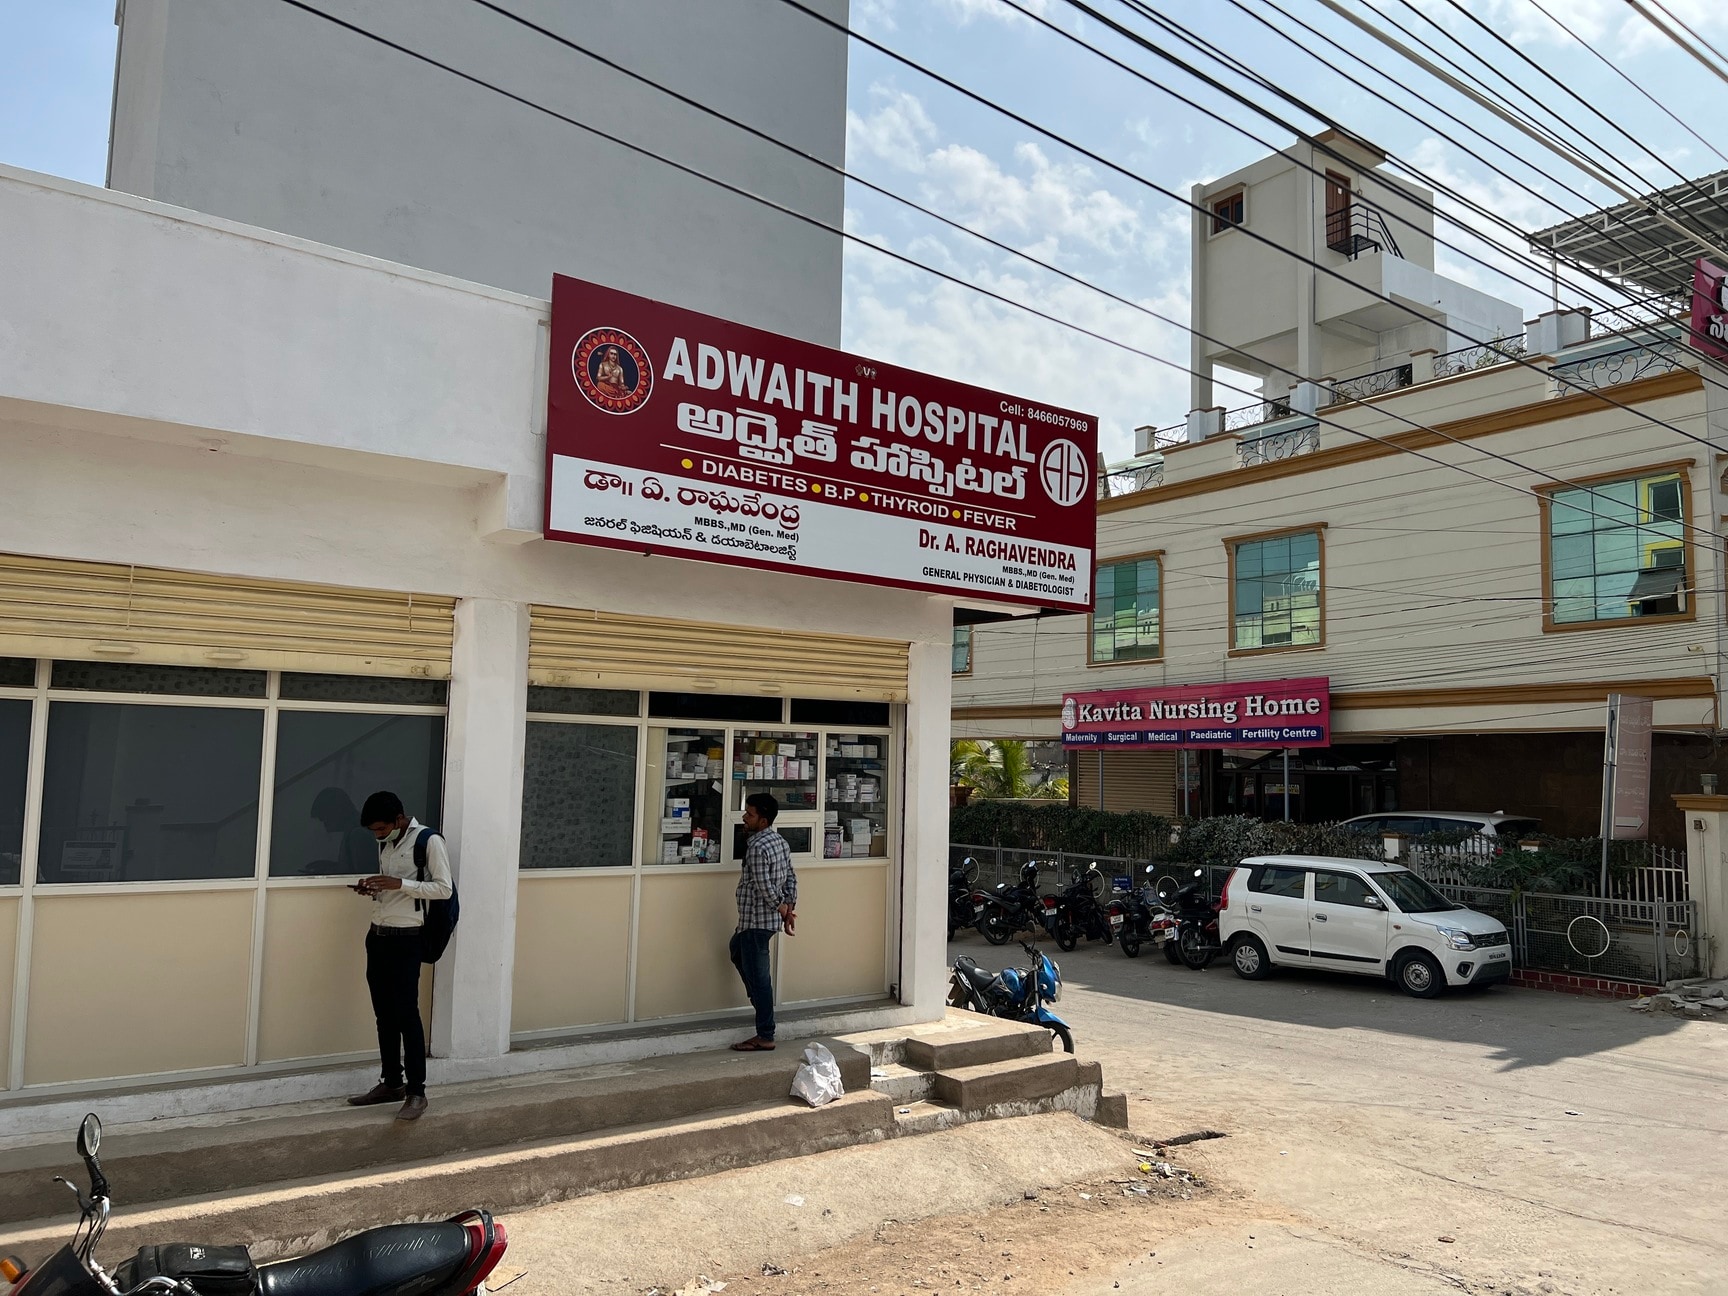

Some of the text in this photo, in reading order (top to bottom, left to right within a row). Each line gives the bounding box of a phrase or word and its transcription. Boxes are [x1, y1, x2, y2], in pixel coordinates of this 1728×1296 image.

[663, 336, 1036, 464] ADWAITH HOSPITAL
[1000, 401, 1088, 433] Cell: 8466057969
[677, 402, 838, 465] అద్వైత్
[677, 486, 801, 531] రాఘవేంద్ర
[702, 459, 1016, 530] DIABETES B.P THYROID FEVER
[584, 515, 628, 531] జనరల్
[630, 519, 693, 541] ఫిజిషియన్
[695, 531, 708, 543] &
[748, 524, 774, 539] (Gen.
[776, 528, 800, 543] Med)
[918, 528, 1077, 571] Dr. A. RAGHAVENDRA
[922, 566, 1074, 597] GENERAL PHYSICIAN & DIABETOLOGIST
[1039, 569, 1057, 581] (Gen.
[1058, 573, 1075, 585] Med)
[1078, 695, 1320, 724] Kavita Nursing Home
[1065, 727, 1317, 743] Maternity Surgical Medical Paediatric Fertility Centre
